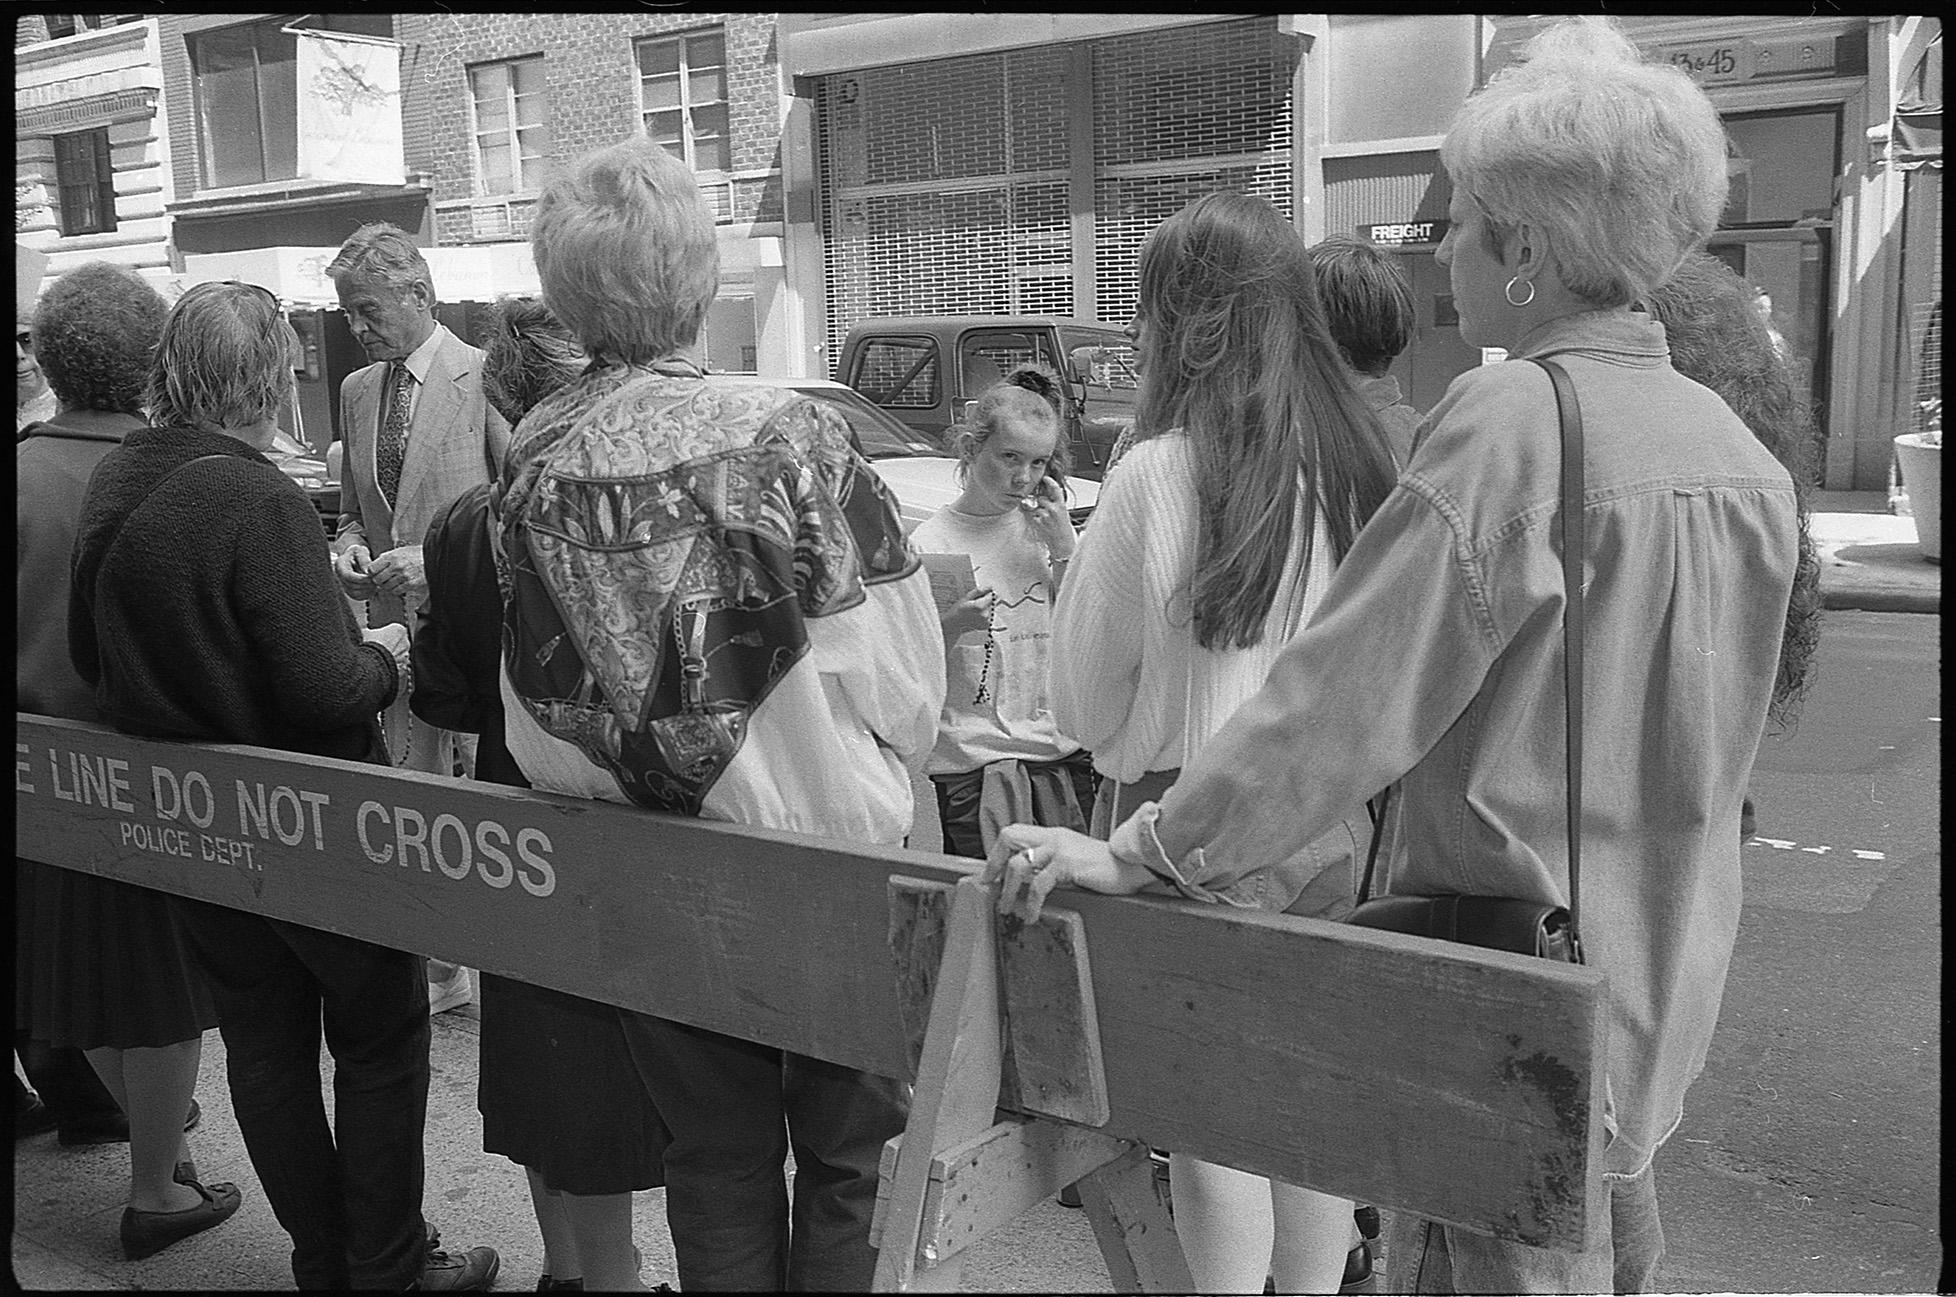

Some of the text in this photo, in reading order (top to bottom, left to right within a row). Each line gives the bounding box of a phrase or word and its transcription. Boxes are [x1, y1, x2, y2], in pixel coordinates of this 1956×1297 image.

[1371, 223, 1434, 240] FREIGHT
[49, 748, 135, 813] LINE
[151, 765, 215, 829] DO
[236, 779, 330, 851] NOT
[356, 800, 556, 897] CROSS
[120, 821, 263, 871] POLICE DEPT.
